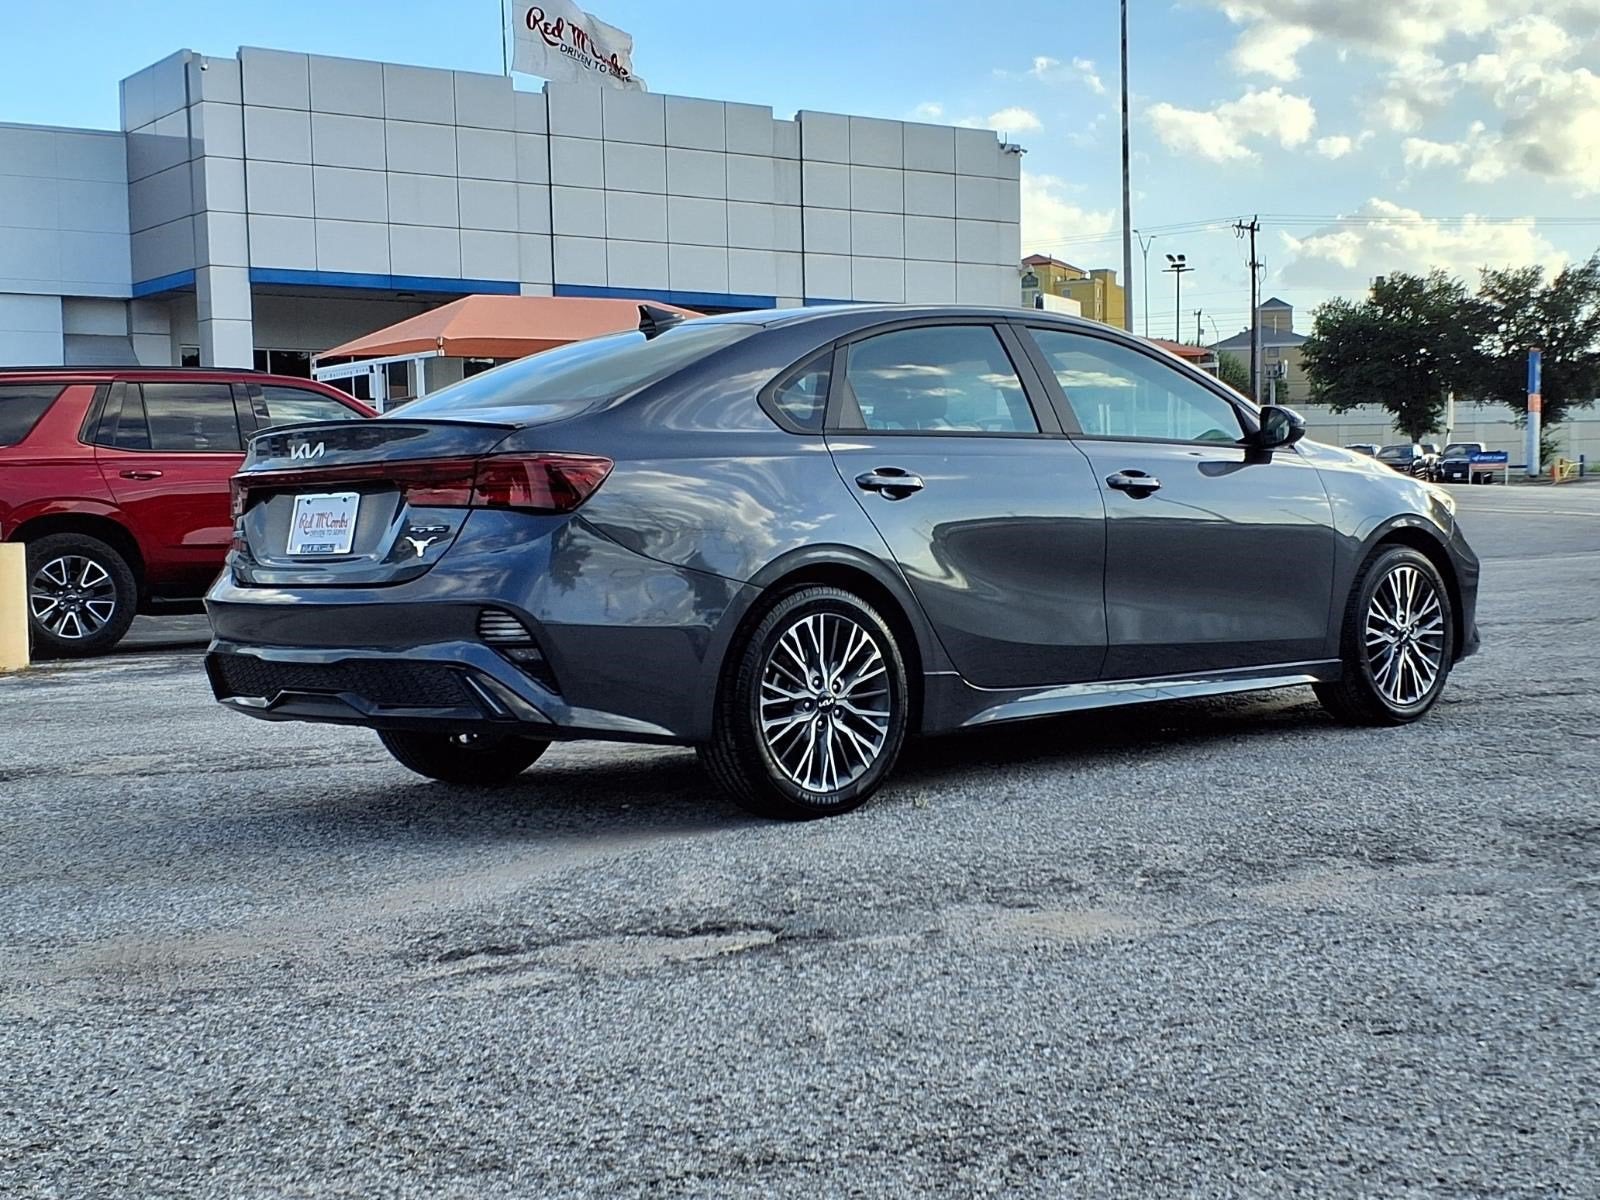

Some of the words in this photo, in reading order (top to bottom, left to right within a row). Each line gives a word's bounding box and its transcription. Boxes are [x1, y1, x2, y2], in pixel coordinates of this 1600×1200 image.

[526, 6, 565, 46] Red
[567, 20, 629, 76] McCbs
[560, 43, 592, 67] DRIVEN
[594, 59, 607, 73] TO
[291, 441, 325, 459] KIA
[298, 512, 314, 535] Red
